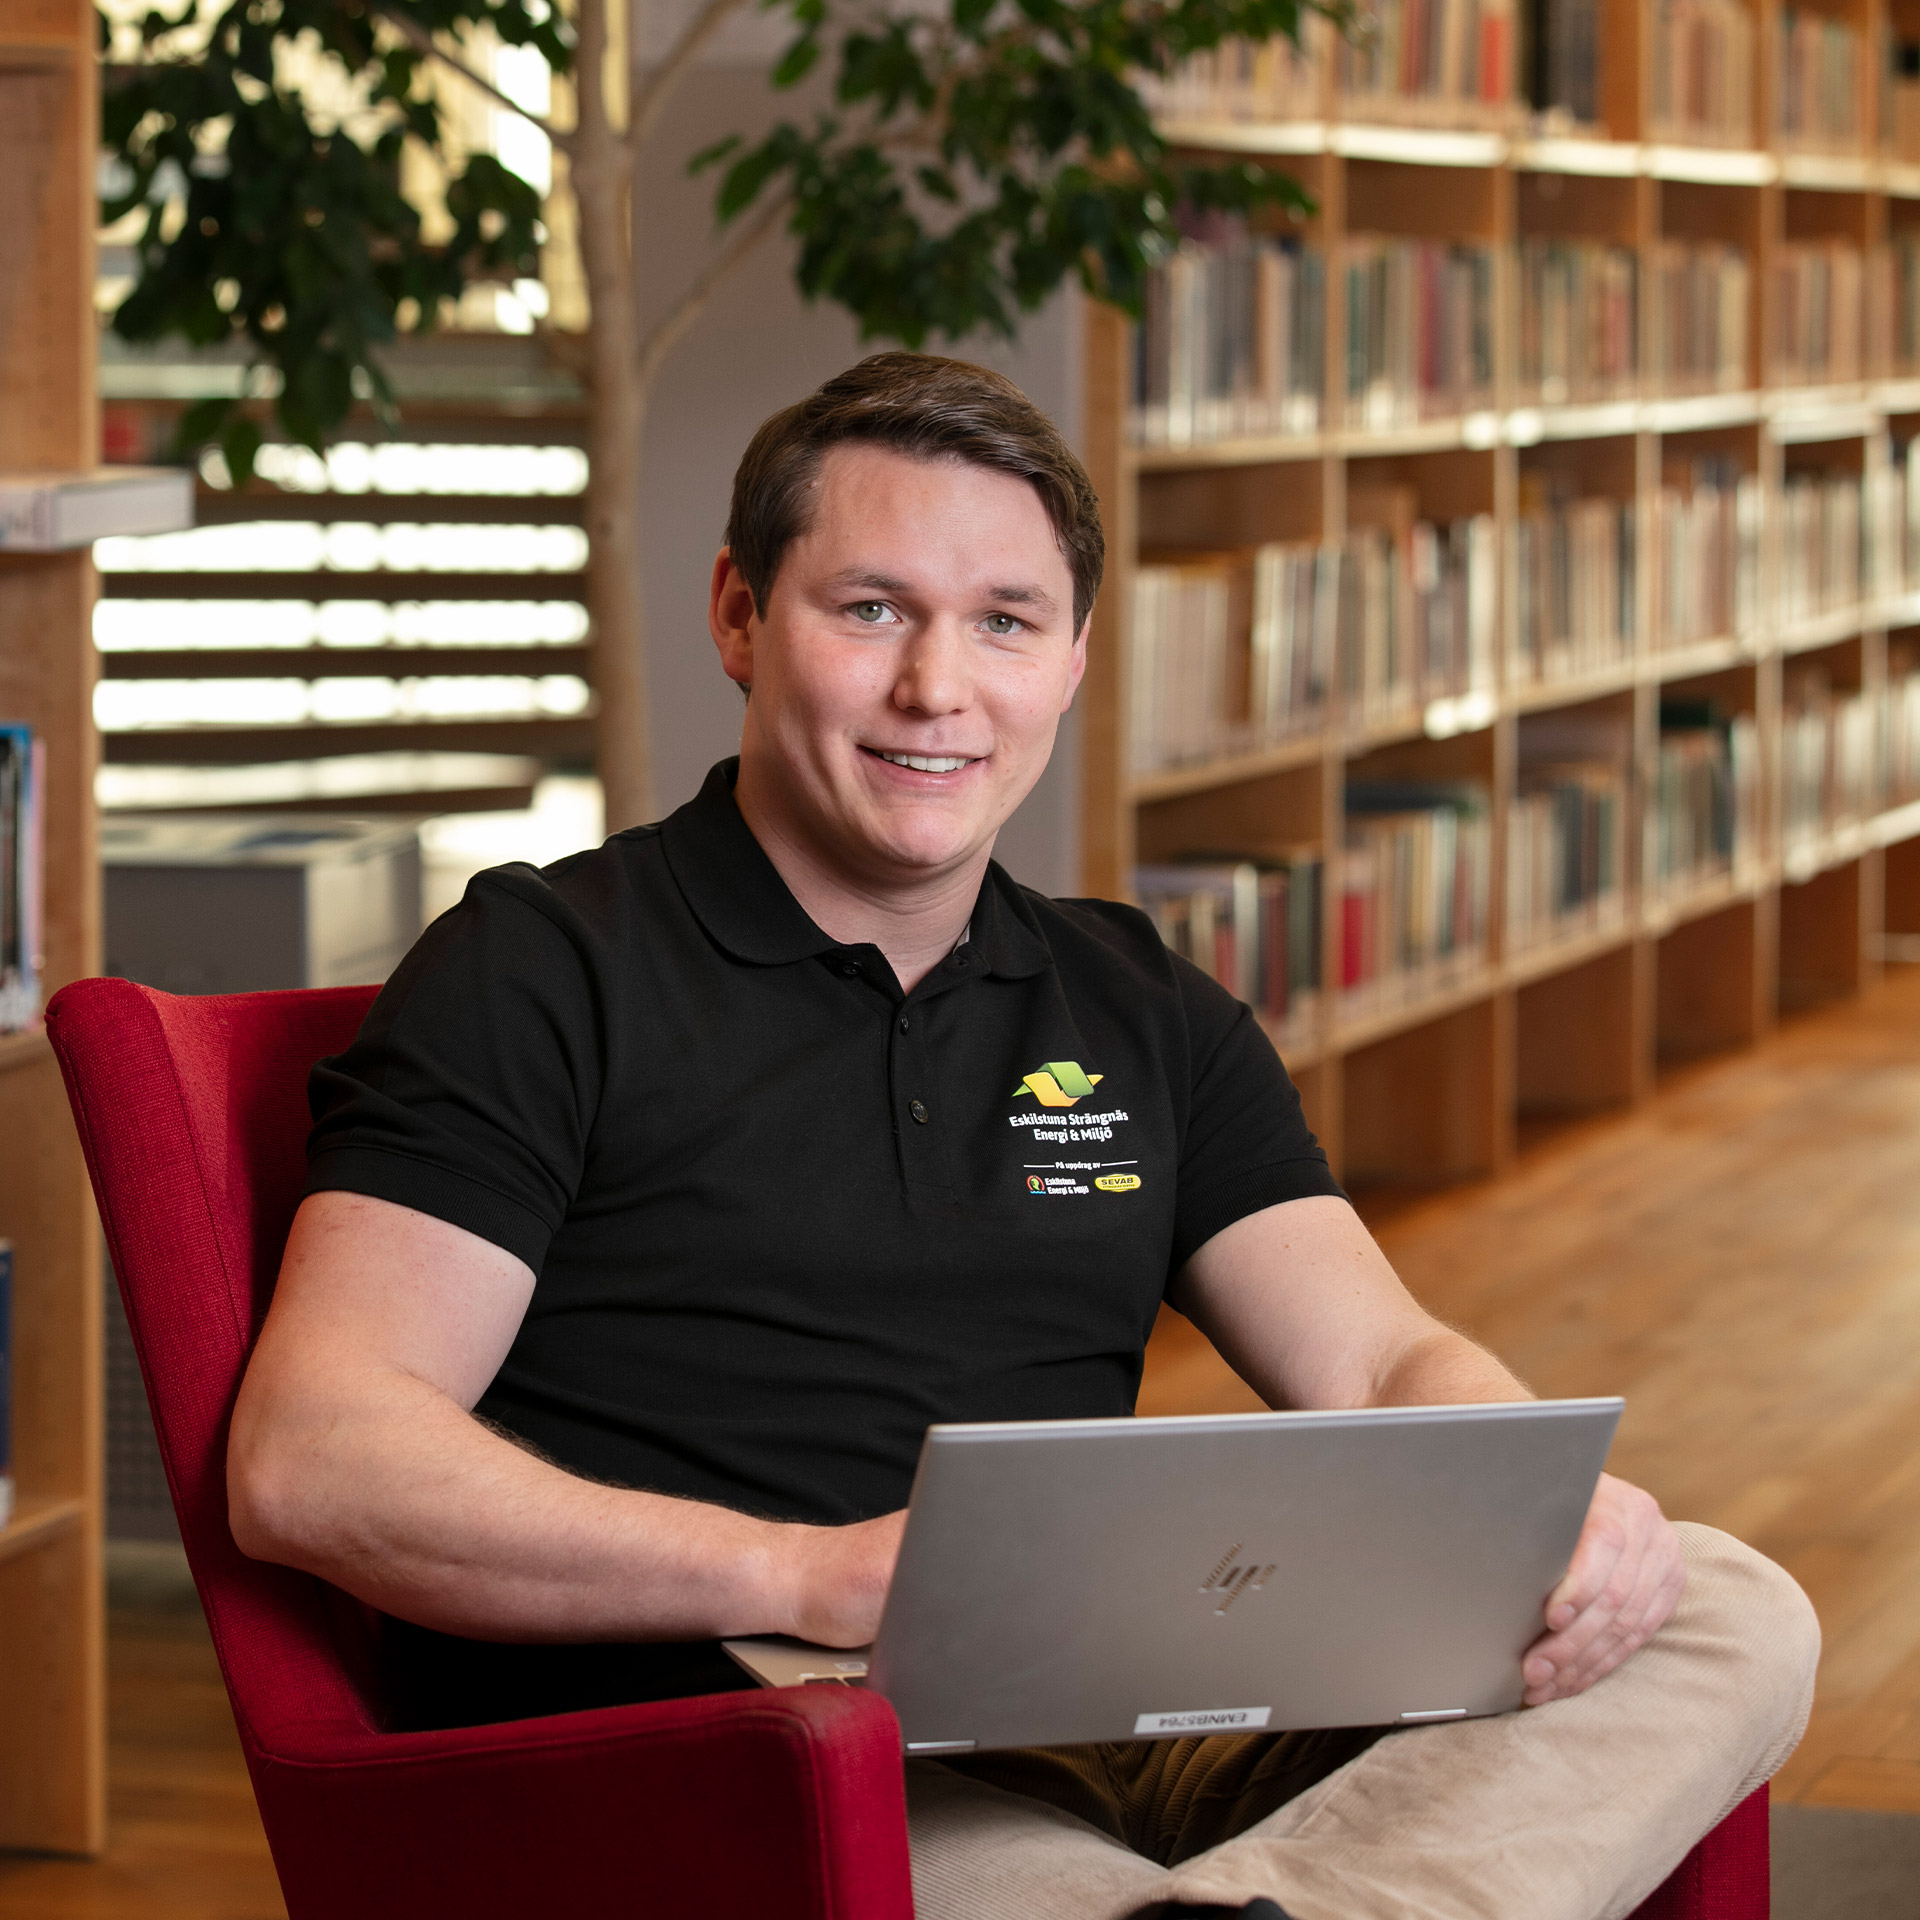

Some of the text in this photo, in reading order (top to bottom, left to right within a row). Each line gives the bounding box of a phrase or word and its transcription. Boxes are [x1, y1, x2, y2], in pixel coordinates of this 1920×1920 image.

[1009, 1109, 1129, 1127] Eskilstuna Strängnäs
[1033, 1126, 1112, 1144] Energi & Miljö
[1055, 1161, 1065, 1169] På
[1065, 1161, 1092, 1170] uppdrag
[1044, 1177, 1076, 1186] Eskilstuna
[1101, 1177, 1134, 1185] SEVAB
[1047, 1186, 1068, 1195] Energi
[1073, 1185, 1090, 1194] Miljö
